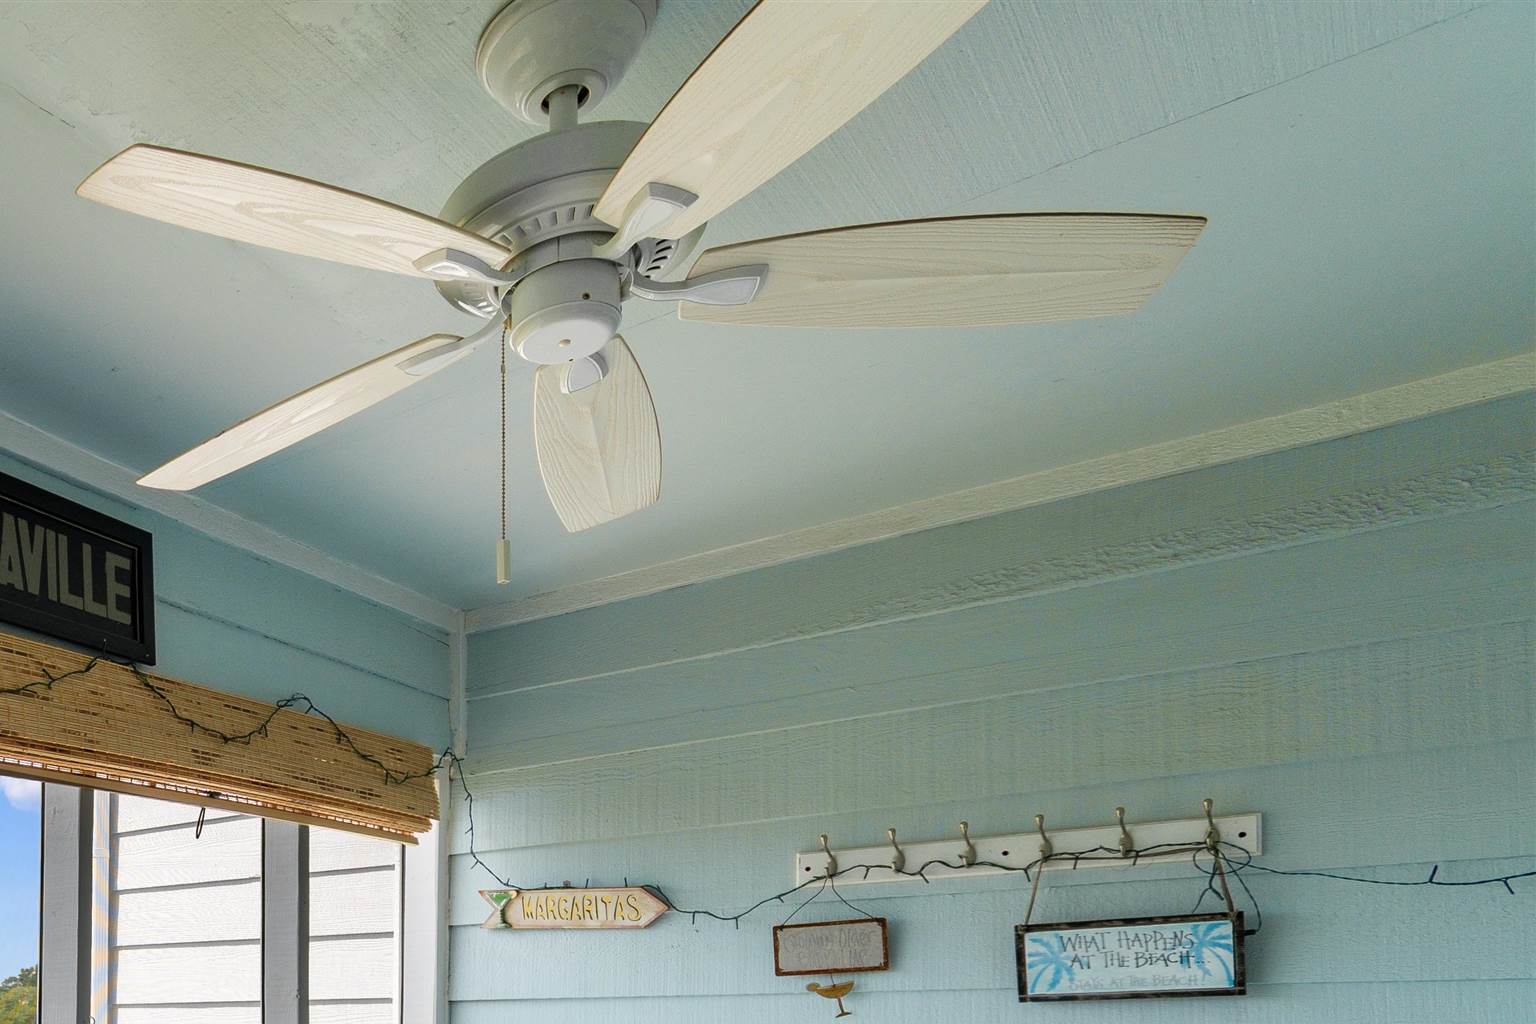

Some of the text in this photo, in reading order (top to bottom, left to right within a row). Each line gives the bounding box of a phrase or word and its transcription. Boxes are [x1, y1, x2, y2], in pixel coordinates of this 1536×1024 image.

[521, 894, 643, 922] MARGARITAS
[1059, 929, 1195, 953] WHAT HAPPENS
[1069, 954, 1097, 970] AT
[1101, 950, 1131, 969] THE
